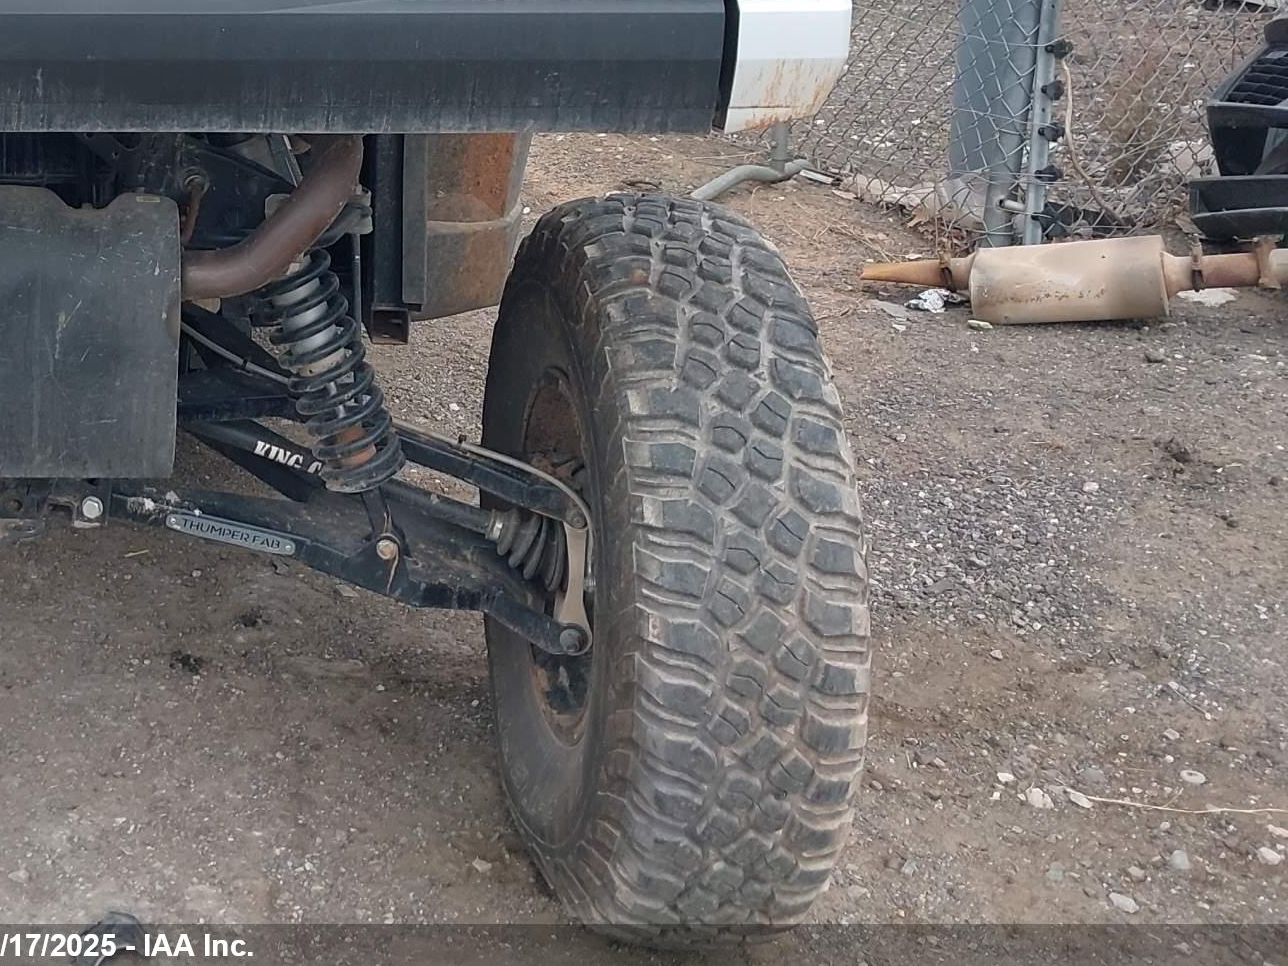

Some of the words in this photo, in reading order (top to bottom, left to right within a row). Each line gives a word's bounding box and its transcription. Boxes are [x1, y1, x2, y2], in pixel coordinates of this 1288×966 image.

[253, 440, 304, 469] KING
[182, 518, 250, 543] THUMPER
[252, 535, 281, 549] FAB
